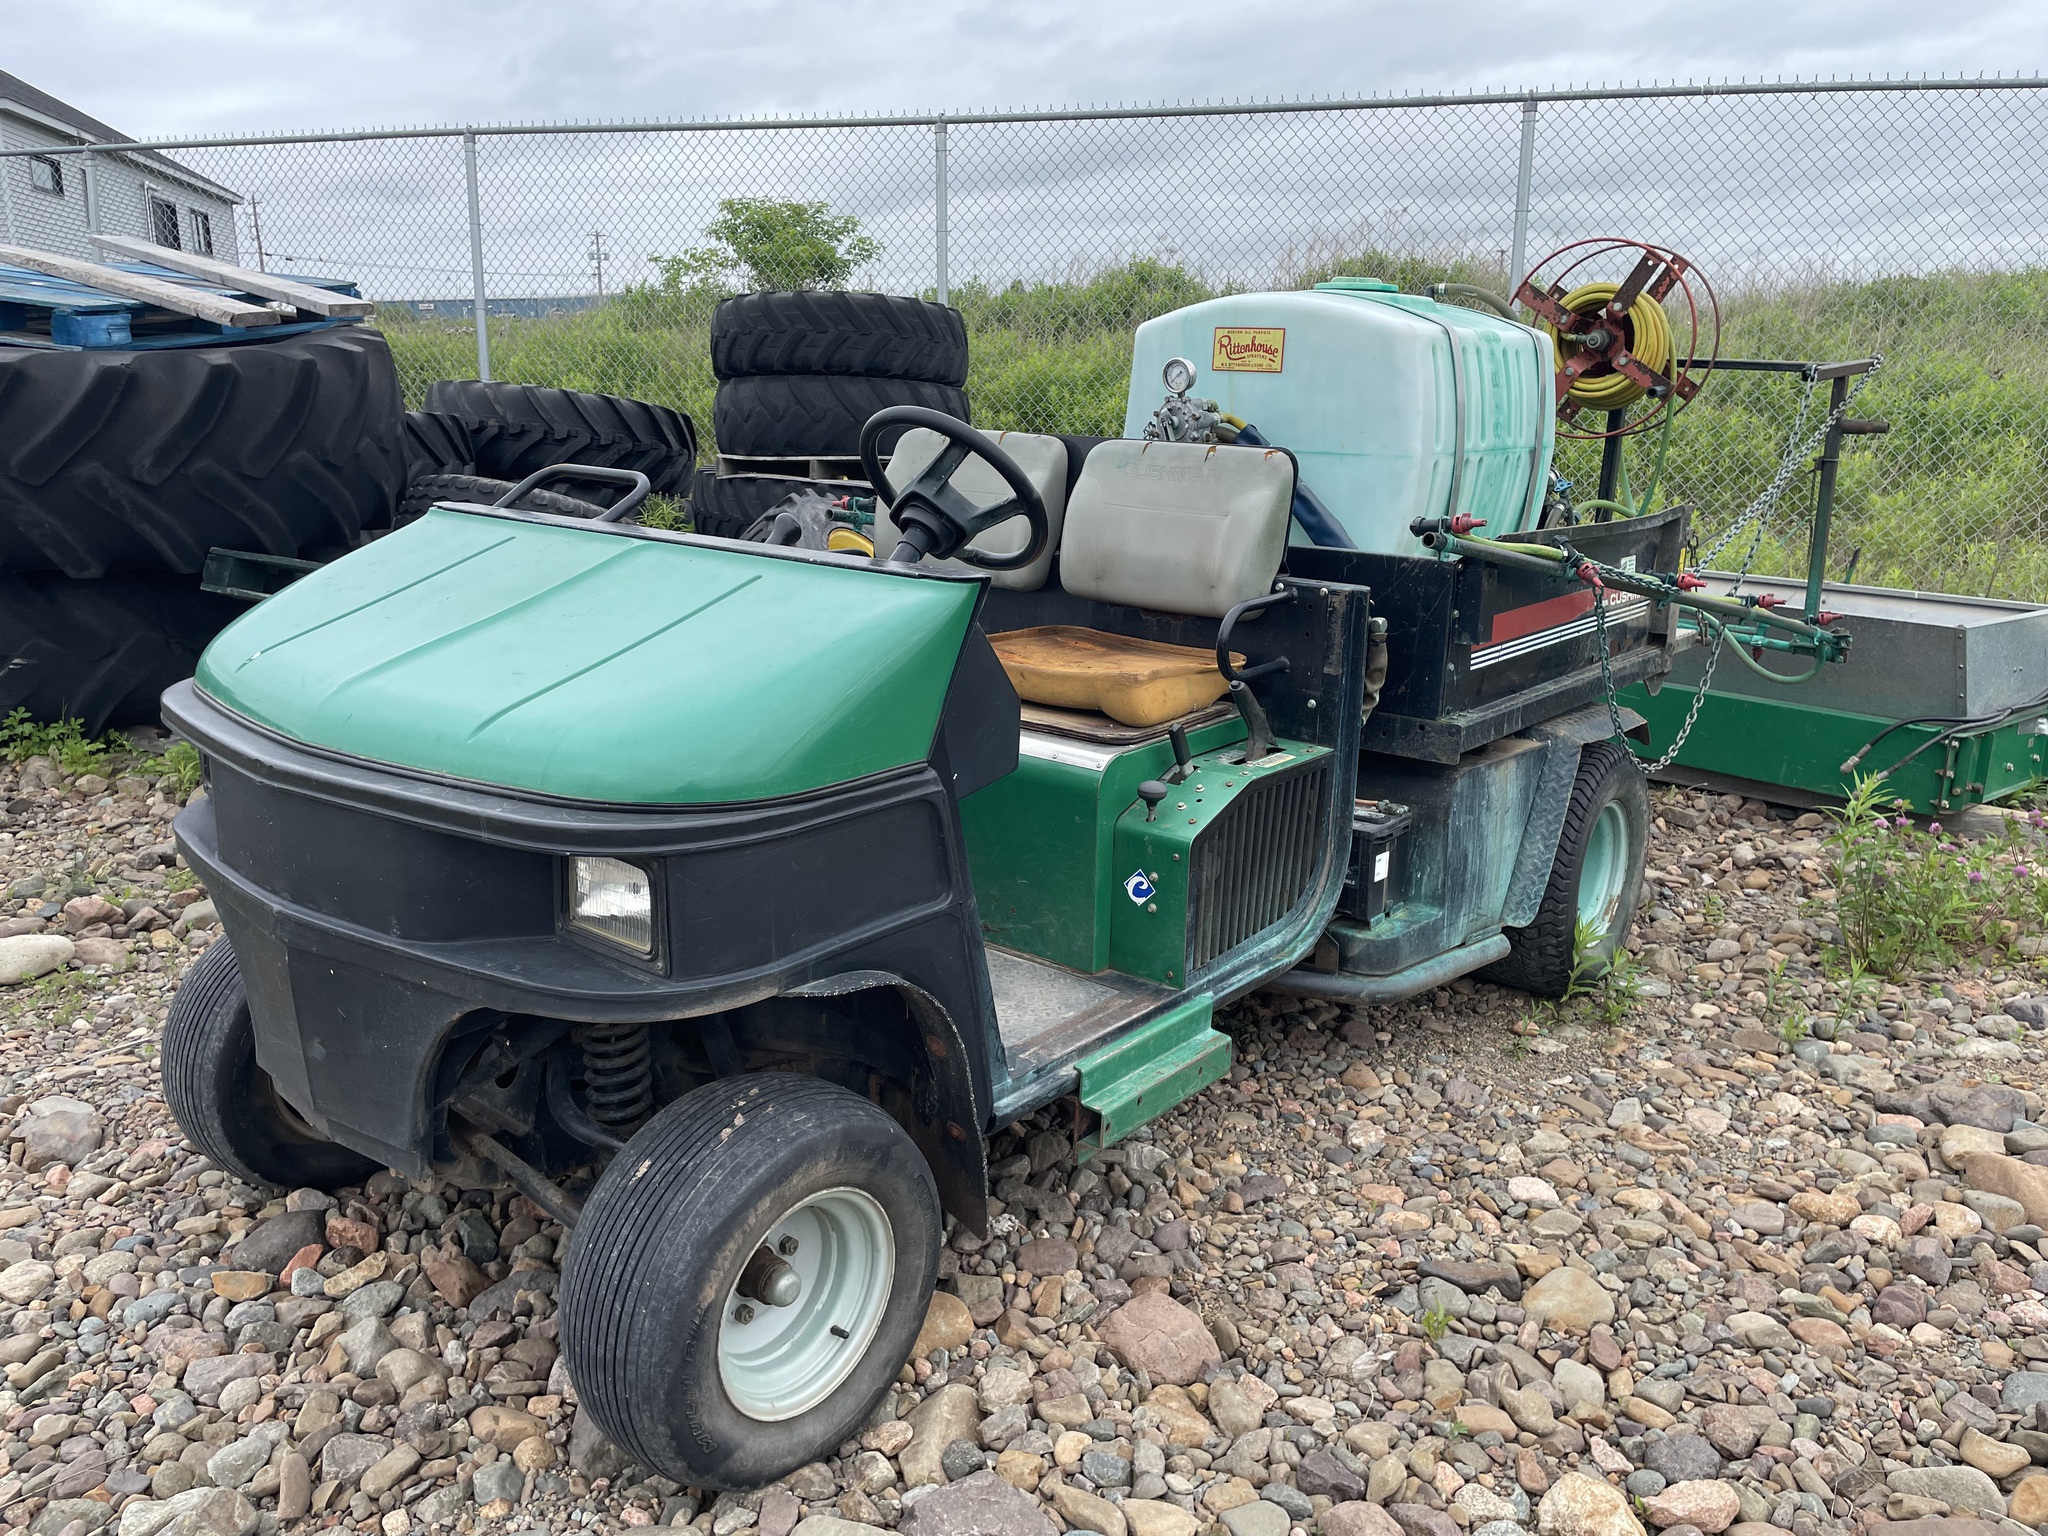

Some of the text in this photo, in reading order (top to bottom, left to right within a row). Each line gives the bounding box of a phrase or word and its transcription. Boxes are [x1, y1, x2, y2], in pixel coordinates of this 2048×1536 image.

[1218, 335, 1279, 361] Rittenhouse
[1123, 462, 1221, 484] CUSHMAN
[681, 1375, 719, 1454] MULTI
